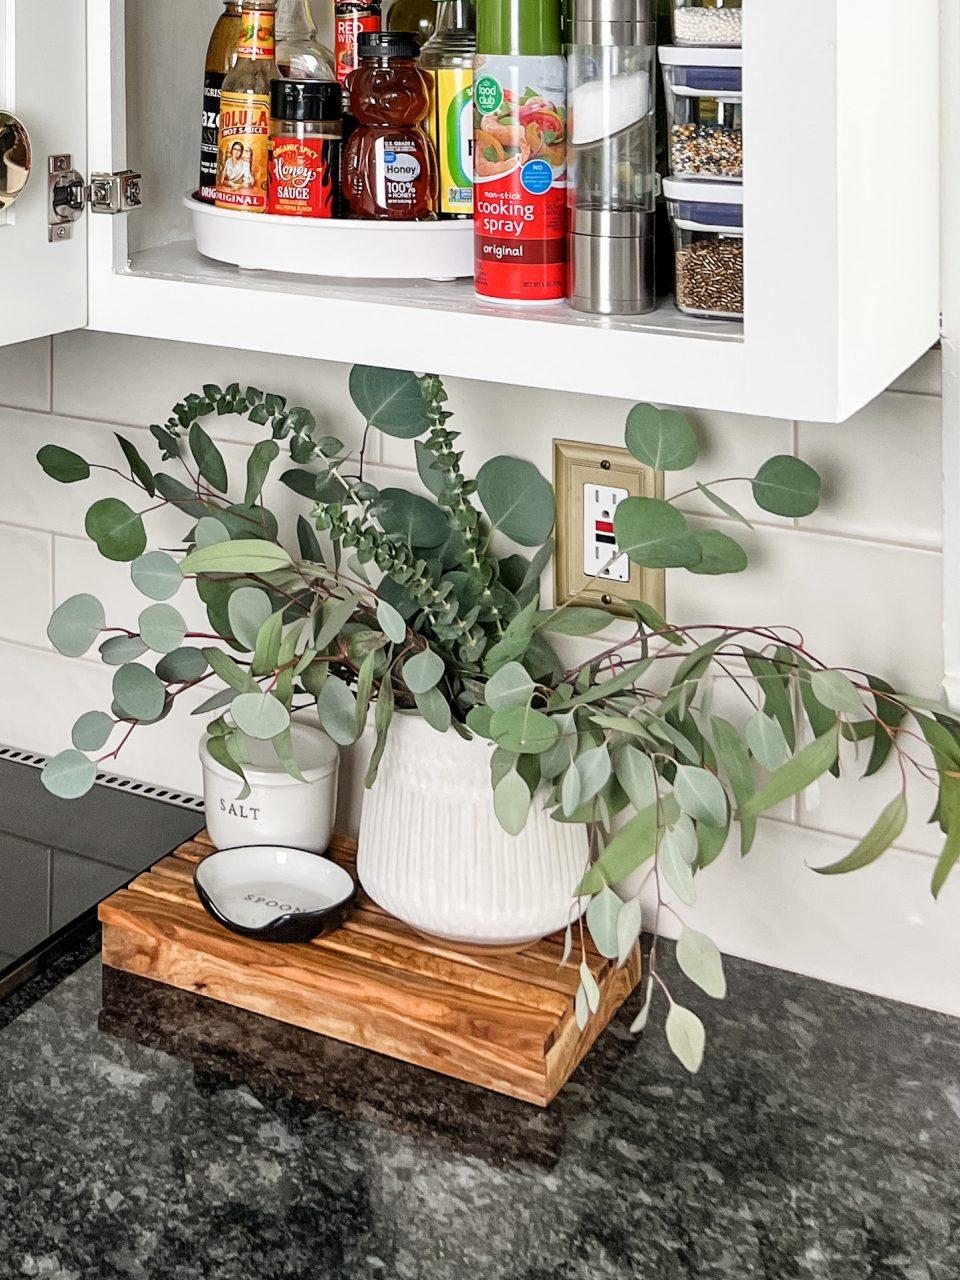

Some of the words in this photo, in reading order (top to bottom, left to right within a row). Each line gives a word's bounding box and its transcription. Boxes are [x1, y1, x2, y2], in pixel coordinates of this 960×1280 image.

[338, 21, 364, 34] RED
[338, 34, 356, 44] WIN
[478, 83, 496, 96] food
[478, 95, 496, 106] club
[222, 128, 238, 137] HOT
[238, 126, 264, 134] SAUCE
[273, 143, 299, 157] ORGANIC
[299, 144, 319, 159] SPICY
[273, 157, 317, 188] Honey
[386, 165, 417, 175] Honey
[201, 186, 216, 199] ORIG
[277, 186, 310, 199] SAUCE
[387, 181, 416, 194] 100%
[484, 191, 522, 200] non-stick
[477, 200, 535, 221] cooking
[483, 218, 524, 237] spray
[483, 244, 523, 259] original
[219, 798, 261, 821] SALT
